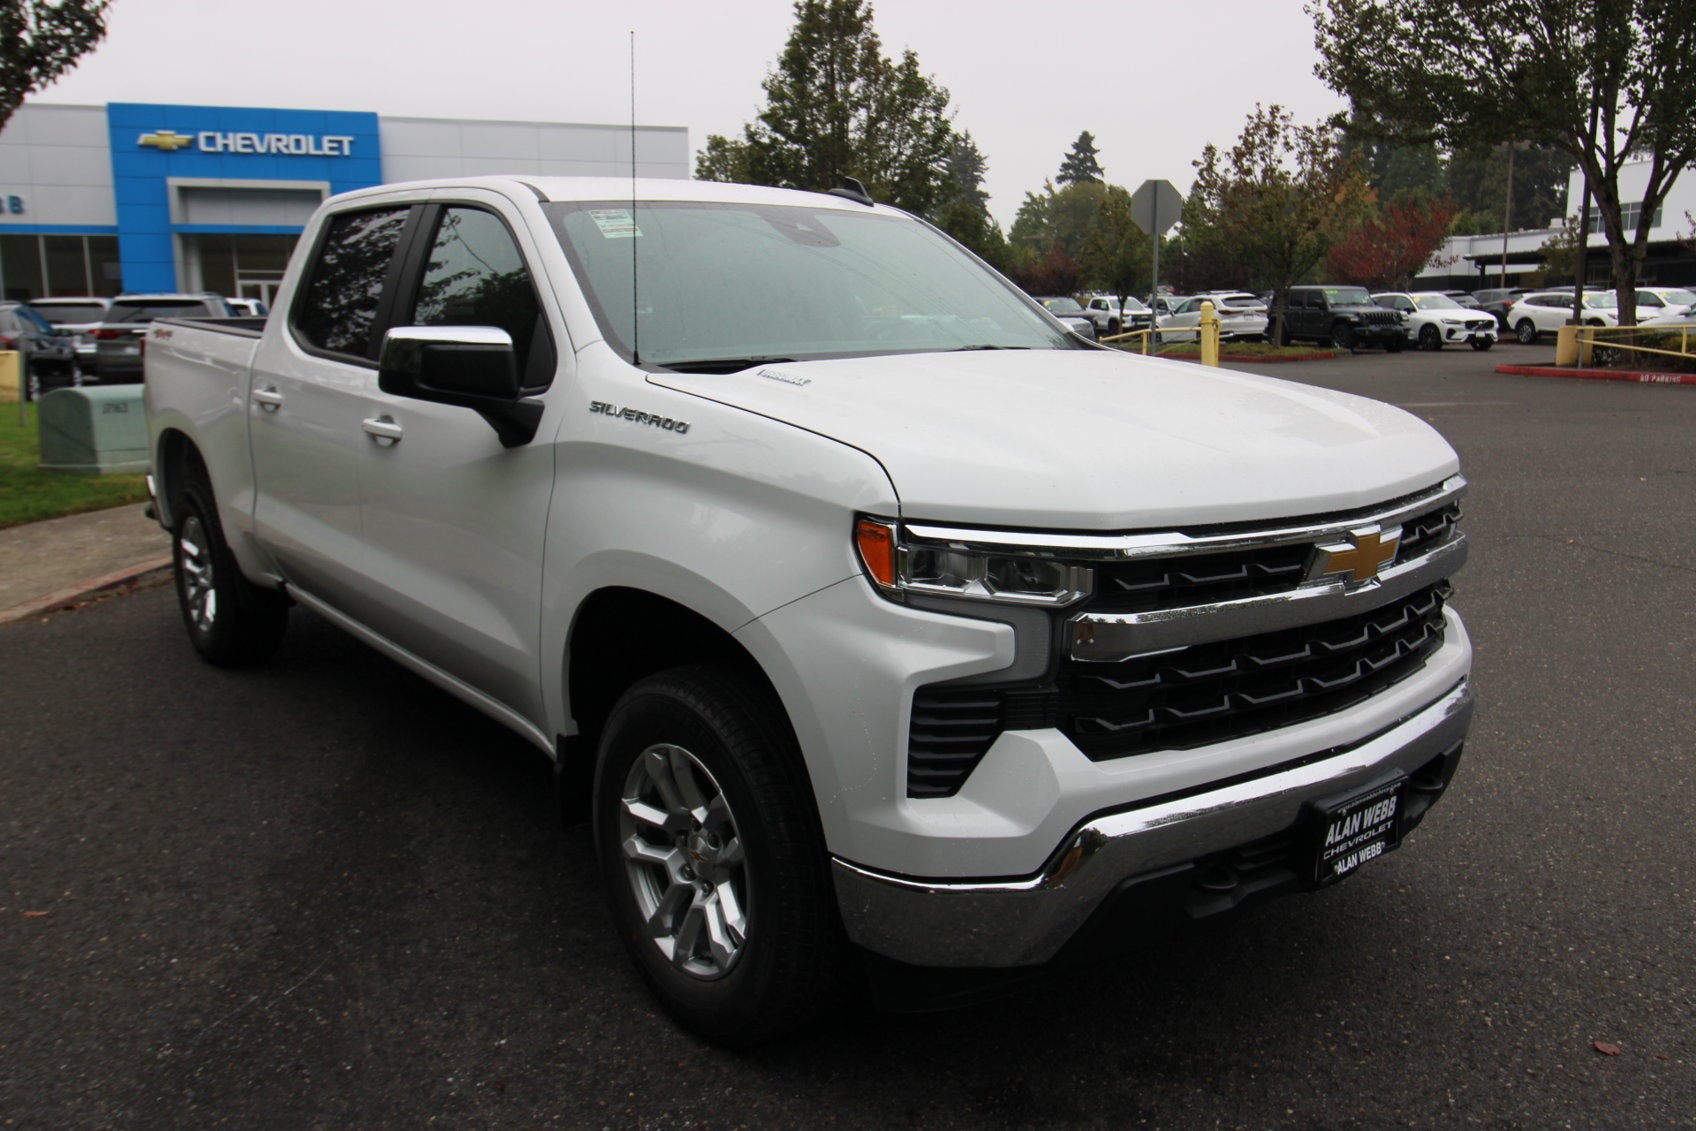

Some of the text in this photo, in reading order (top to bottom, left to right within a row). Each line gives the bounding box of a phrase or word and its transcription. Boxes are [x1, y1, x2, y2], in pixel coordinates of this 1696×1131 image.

[198, 131, 354, 156] CHEVROLET
[589, 400, 690, 434] SILVERADO
[1325, 811, 1362, 847] ALAN
[1363, 796, 1398, 829] WEBB
[1324, 820, 1394, 859] CHEVROLET
[1337, 841, 1382, 875] ALAN WEBB
